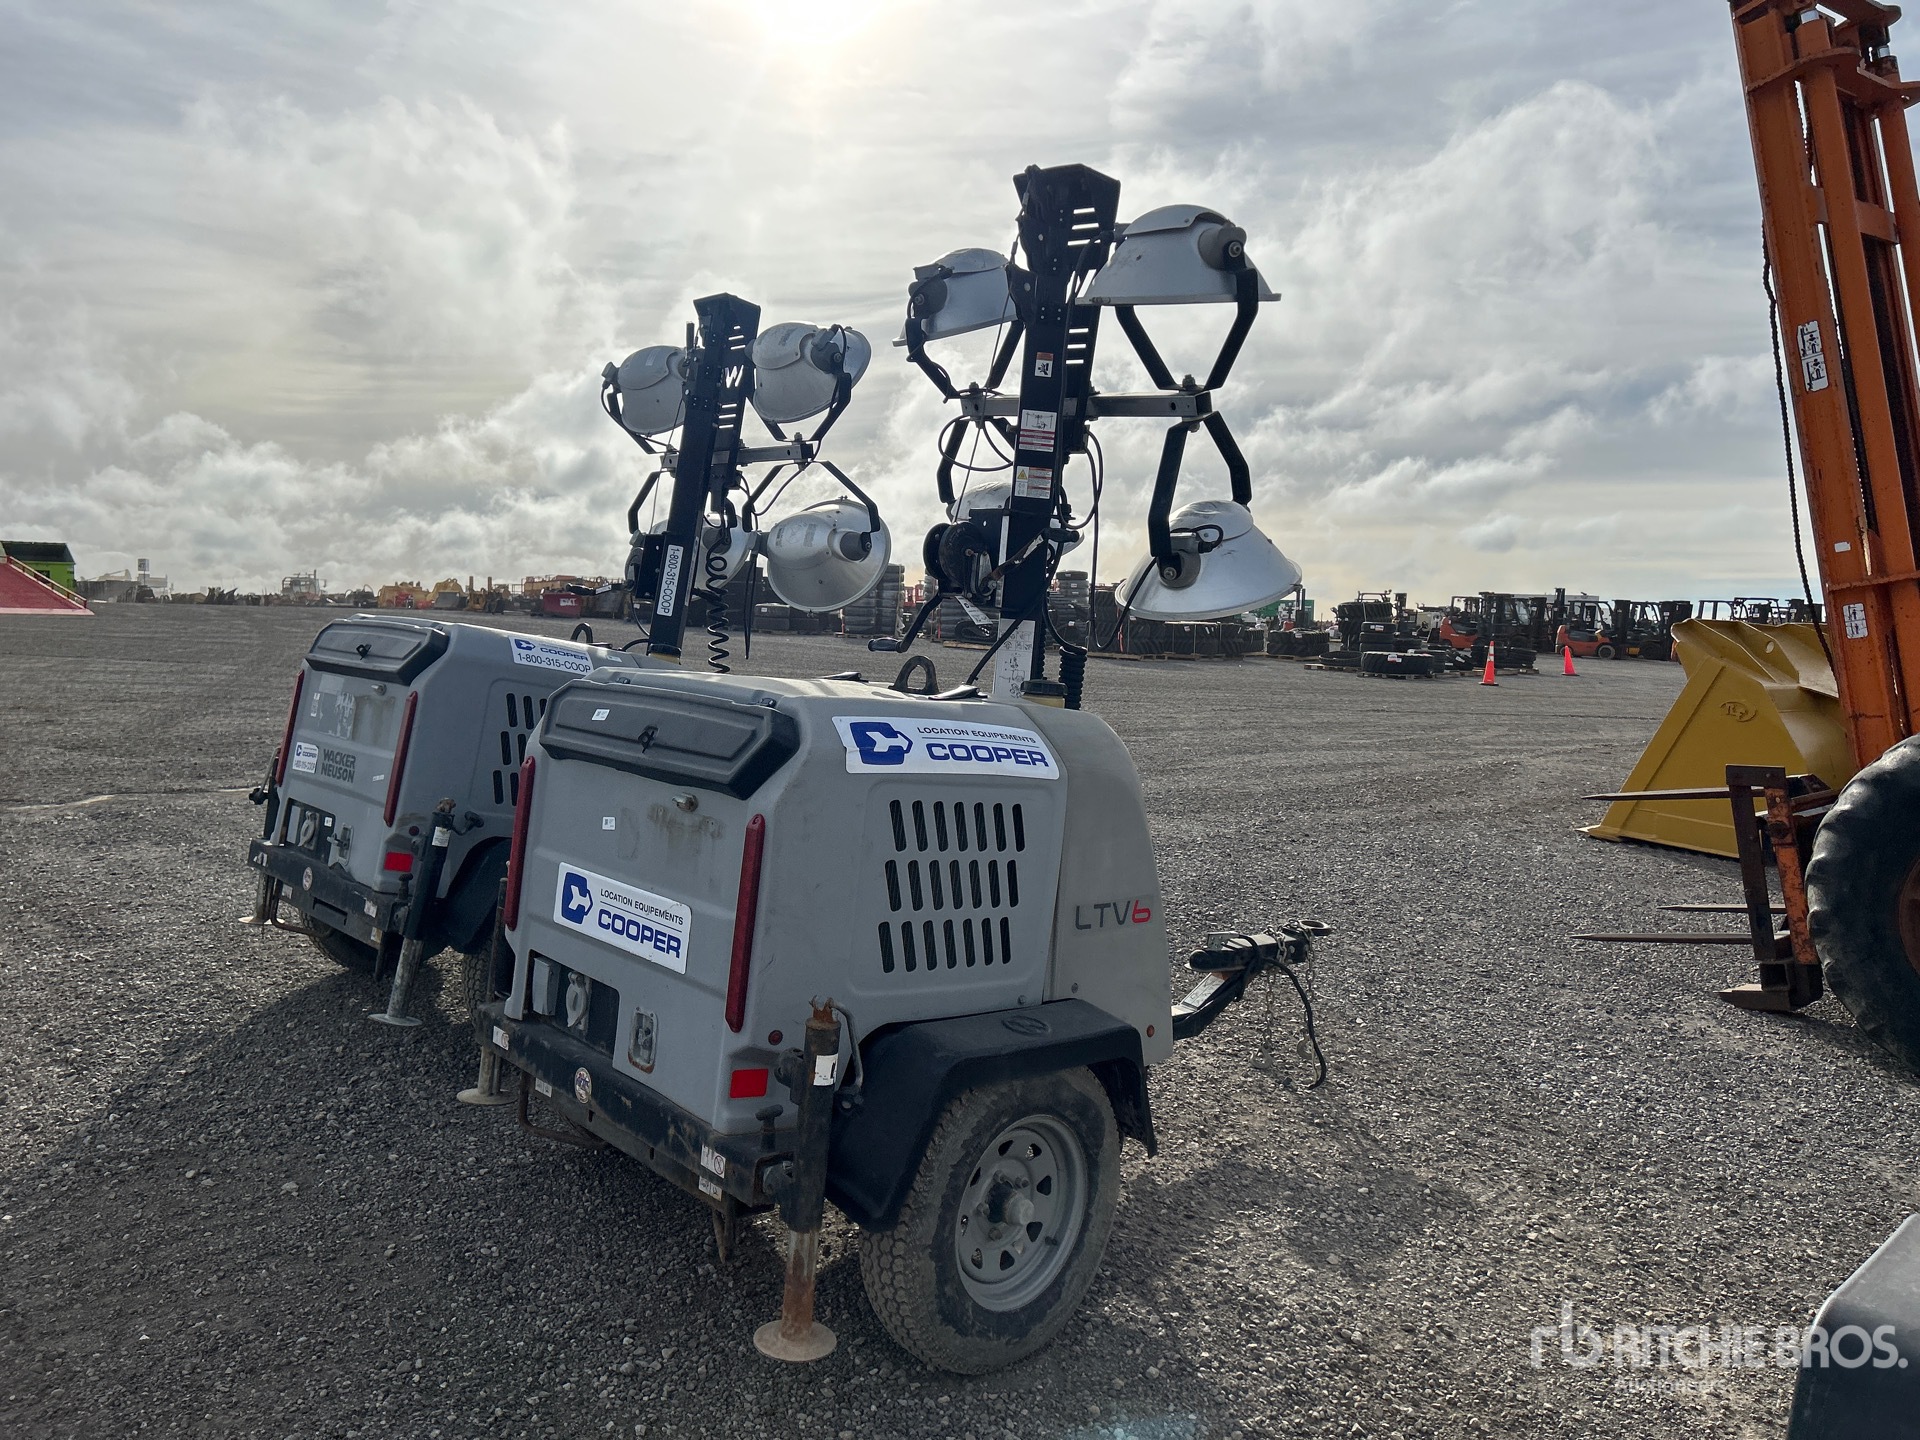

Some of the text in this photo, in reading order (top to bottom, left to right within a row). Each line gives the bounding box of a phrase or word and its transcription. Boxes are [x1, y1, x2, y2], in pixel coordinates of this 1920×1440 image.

[660, 548, 680, 614] 1-800-315-COOP
[517, 653, 591, 673] 1-800-315-COOP
[540, 647, 589, 661] COOPER
[917, 726, 1036, 743] LOCATION EQUIPEMENTS
[323, 748, 356, 769] WACKER
[926, 743, 1049, 767] COOPER
[321, 763, 355, 783] NEUSON
[600, 888, 683, 925] LOCATION EQUIPEMENTS
[1075, 899, 1151, 930] LTV6
[598, 908, 681, 958] COOPER
